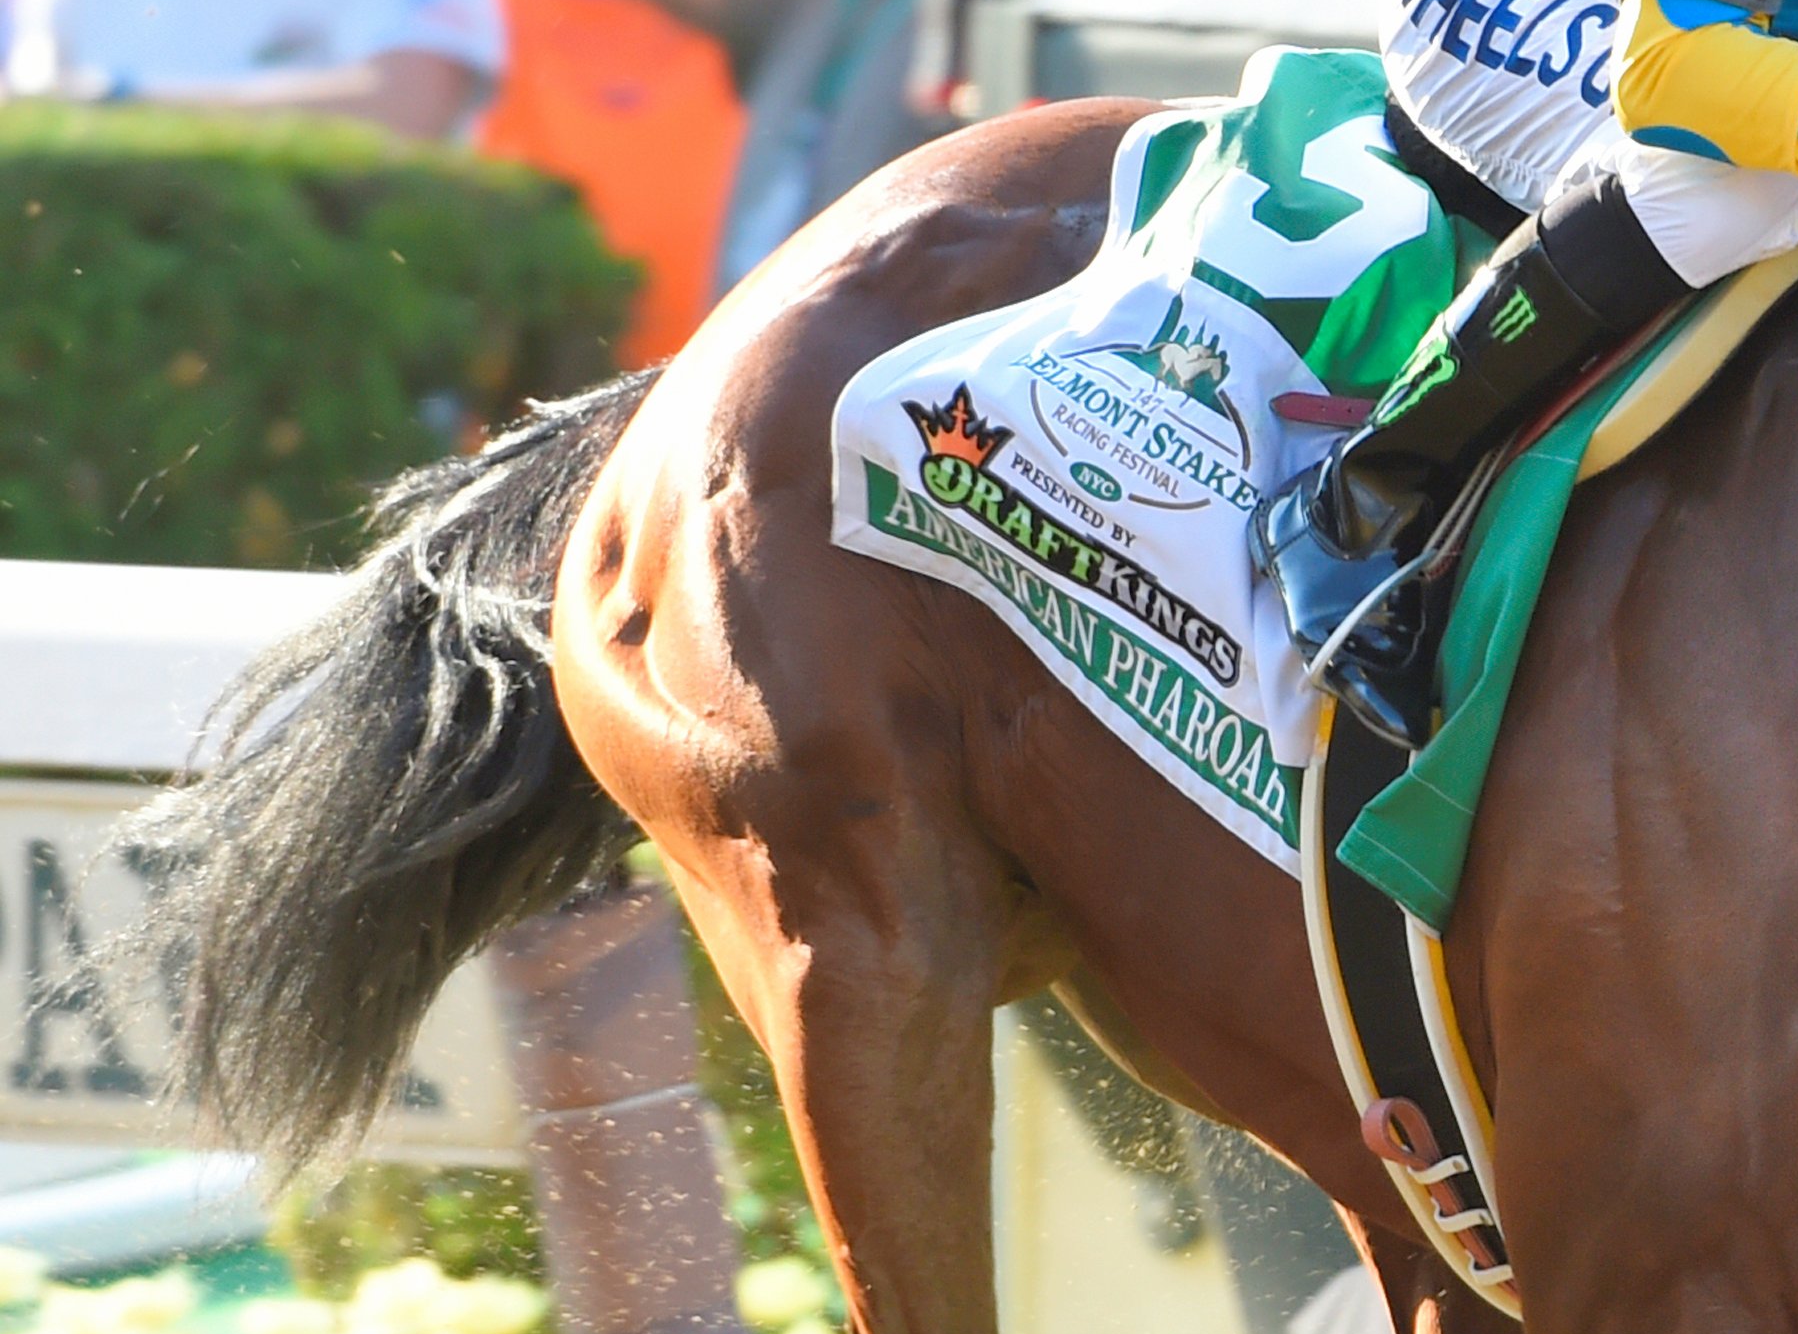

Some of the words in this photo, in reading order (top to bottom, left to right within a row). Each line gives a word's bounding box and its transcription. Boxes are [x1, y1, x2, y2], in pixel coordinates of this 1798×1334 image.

[1051, 403, 1111, 451] RACING
[1109, 442, 1180, 499] FESTIVAL
[1077, 468, 1114, 498] NYC
[1010, 451, 1105, 529] PRESENTED
[1110, 521, 1136, 549] BY
[884, 479, 1099, 668] AMERICAN
